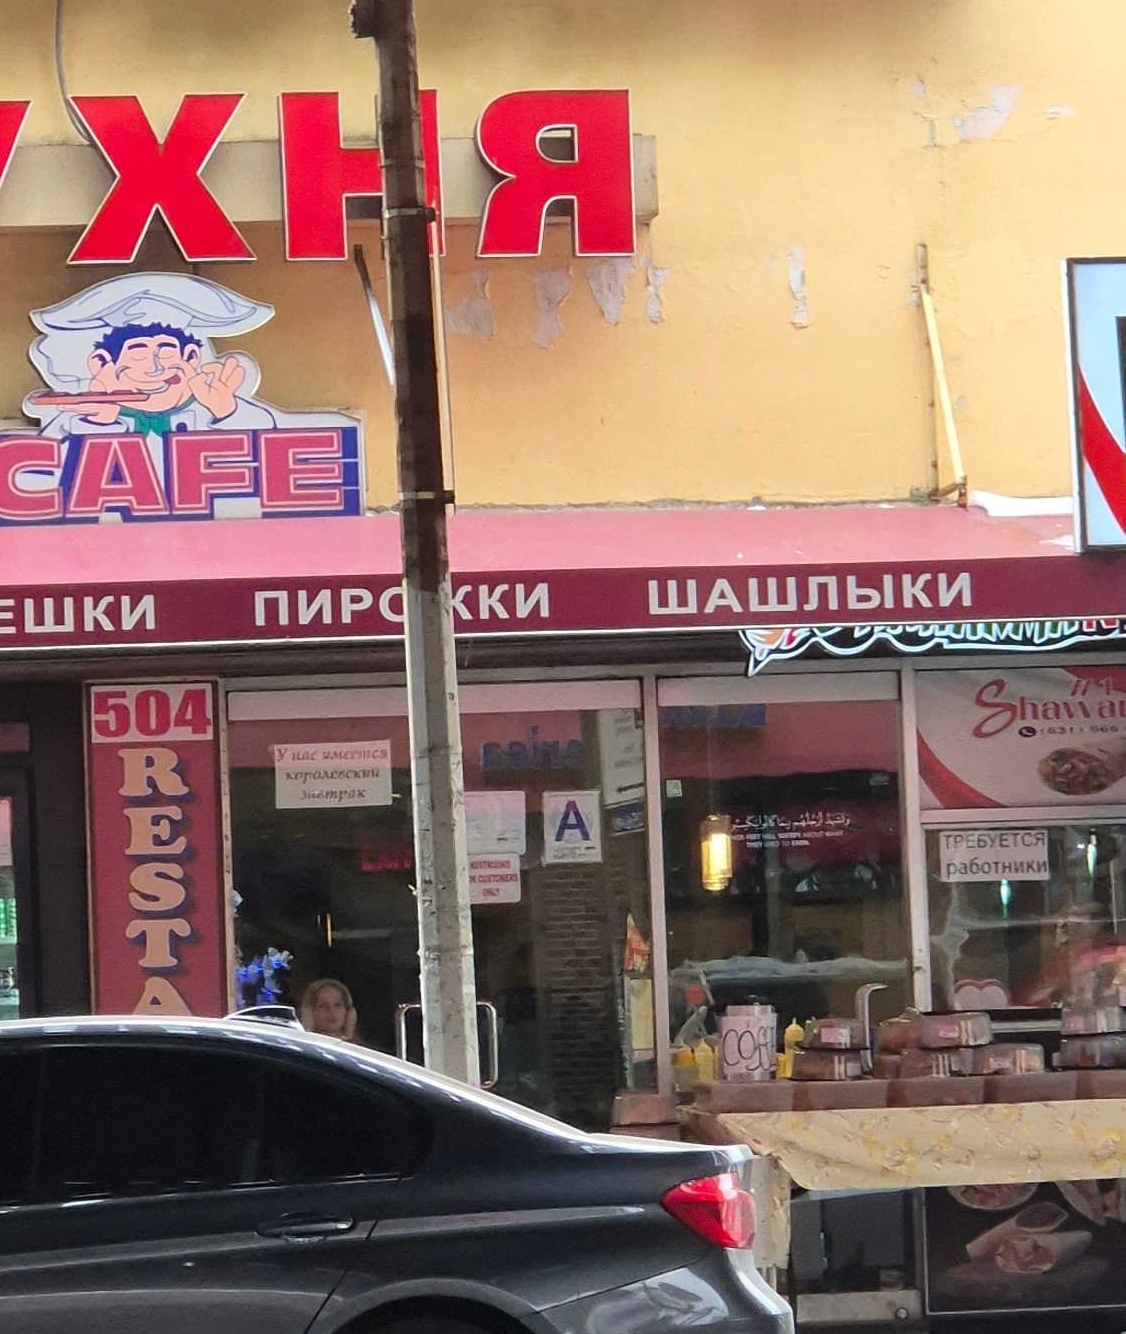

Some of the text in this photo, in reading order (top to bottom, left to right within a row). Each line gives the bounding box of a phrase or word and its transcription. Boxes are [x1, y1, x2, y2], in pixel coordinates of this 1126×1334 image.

[647, 572, 975, 617] ШАШЛЫКИ
[93, 689, 211, 739] 504
[276, 748, 288, 762] У
[291, 750, 316, 761] нас
[300, 788, 367, 802] завтрак
[554, 800, 591, 842] A
[943, 831, 1046, 850] ТРЕБУЕТСЯ
[945, 857, 1048, 880] работники
